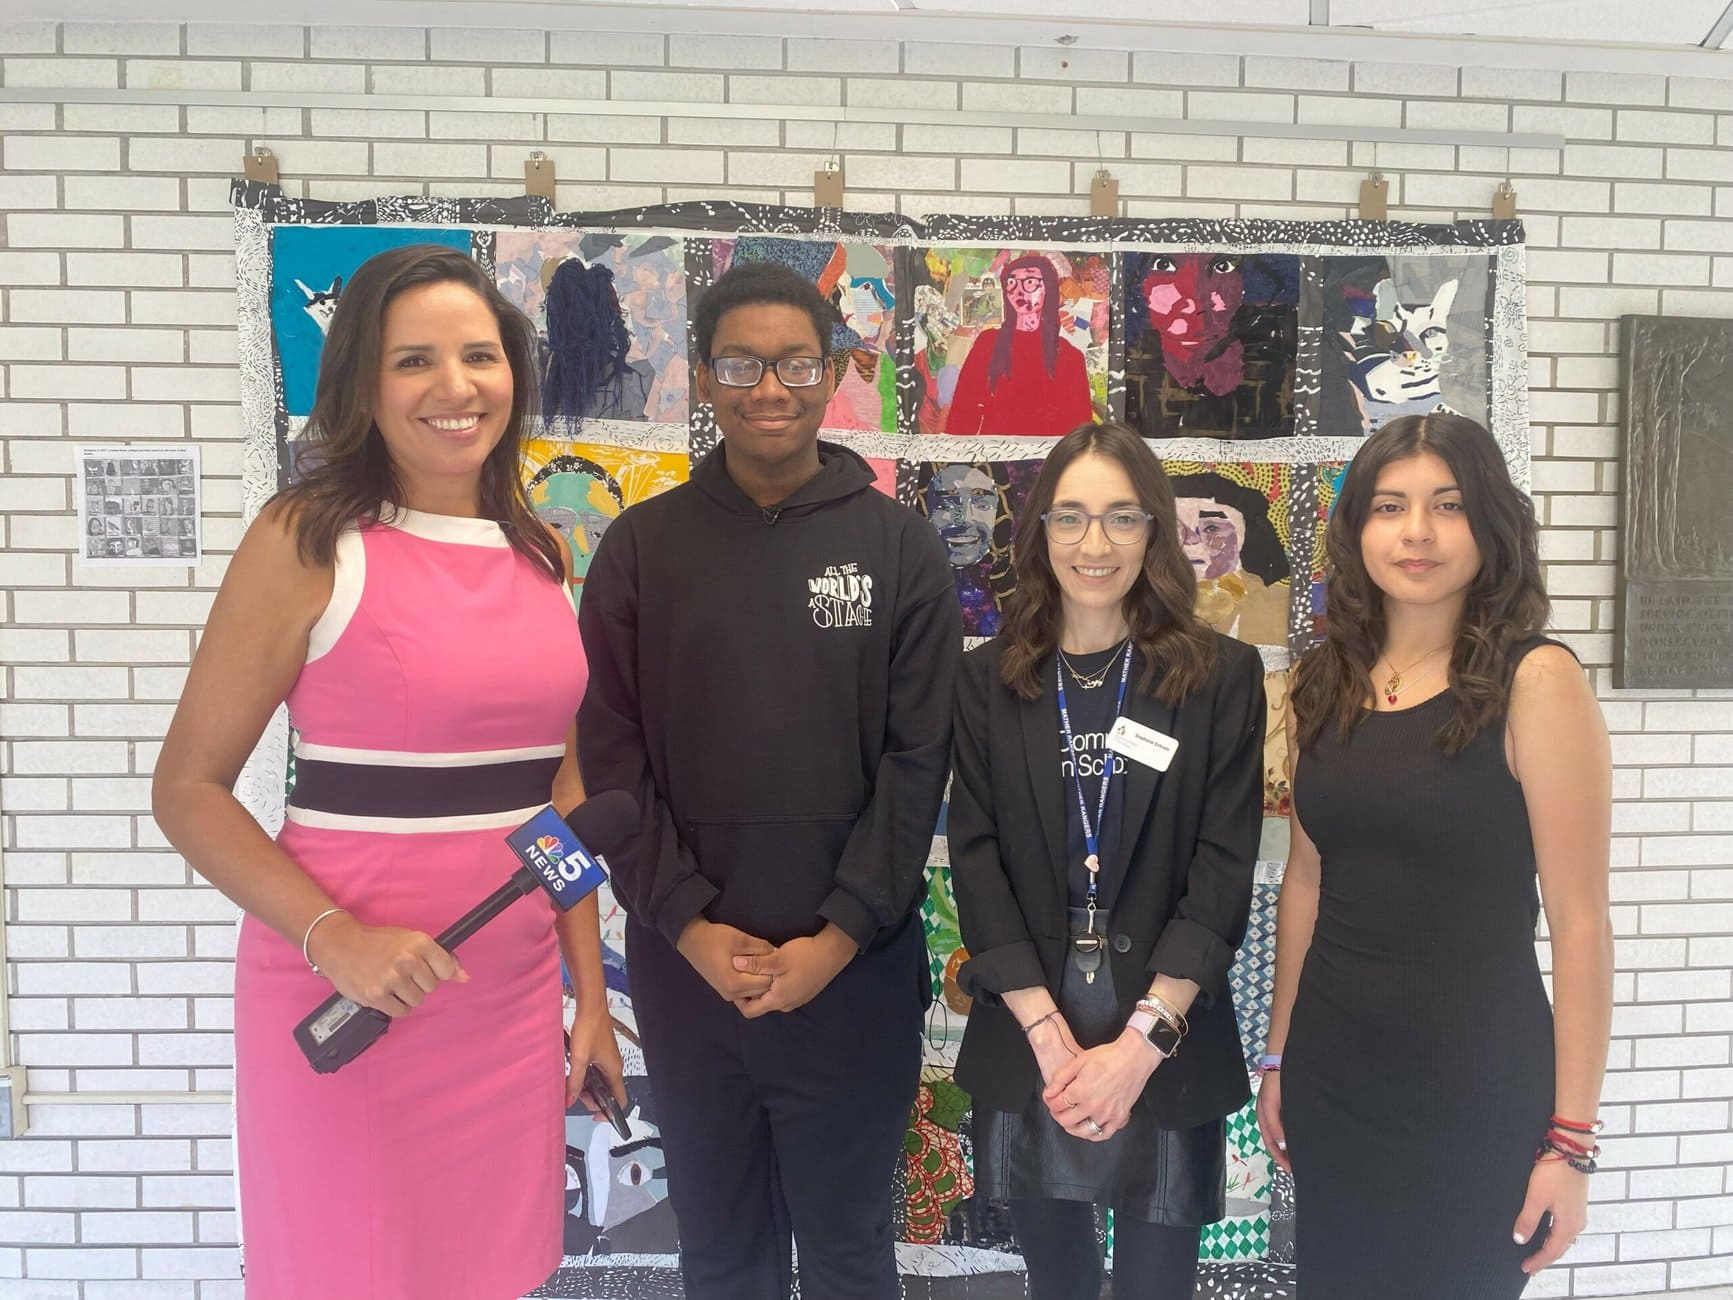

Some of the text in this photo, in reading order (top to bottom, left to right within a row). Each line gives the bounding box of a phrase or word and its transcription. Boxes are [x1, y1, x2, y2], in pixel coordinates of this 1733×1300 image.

[824, 563, 858, 577] ALL THE
[808, 575, 873, 607] WORLD'S
[808, 594, 872, 628] A STAGE
[525, 844, 566, 892] NEWS
[558, 850, 592, 882] 5
